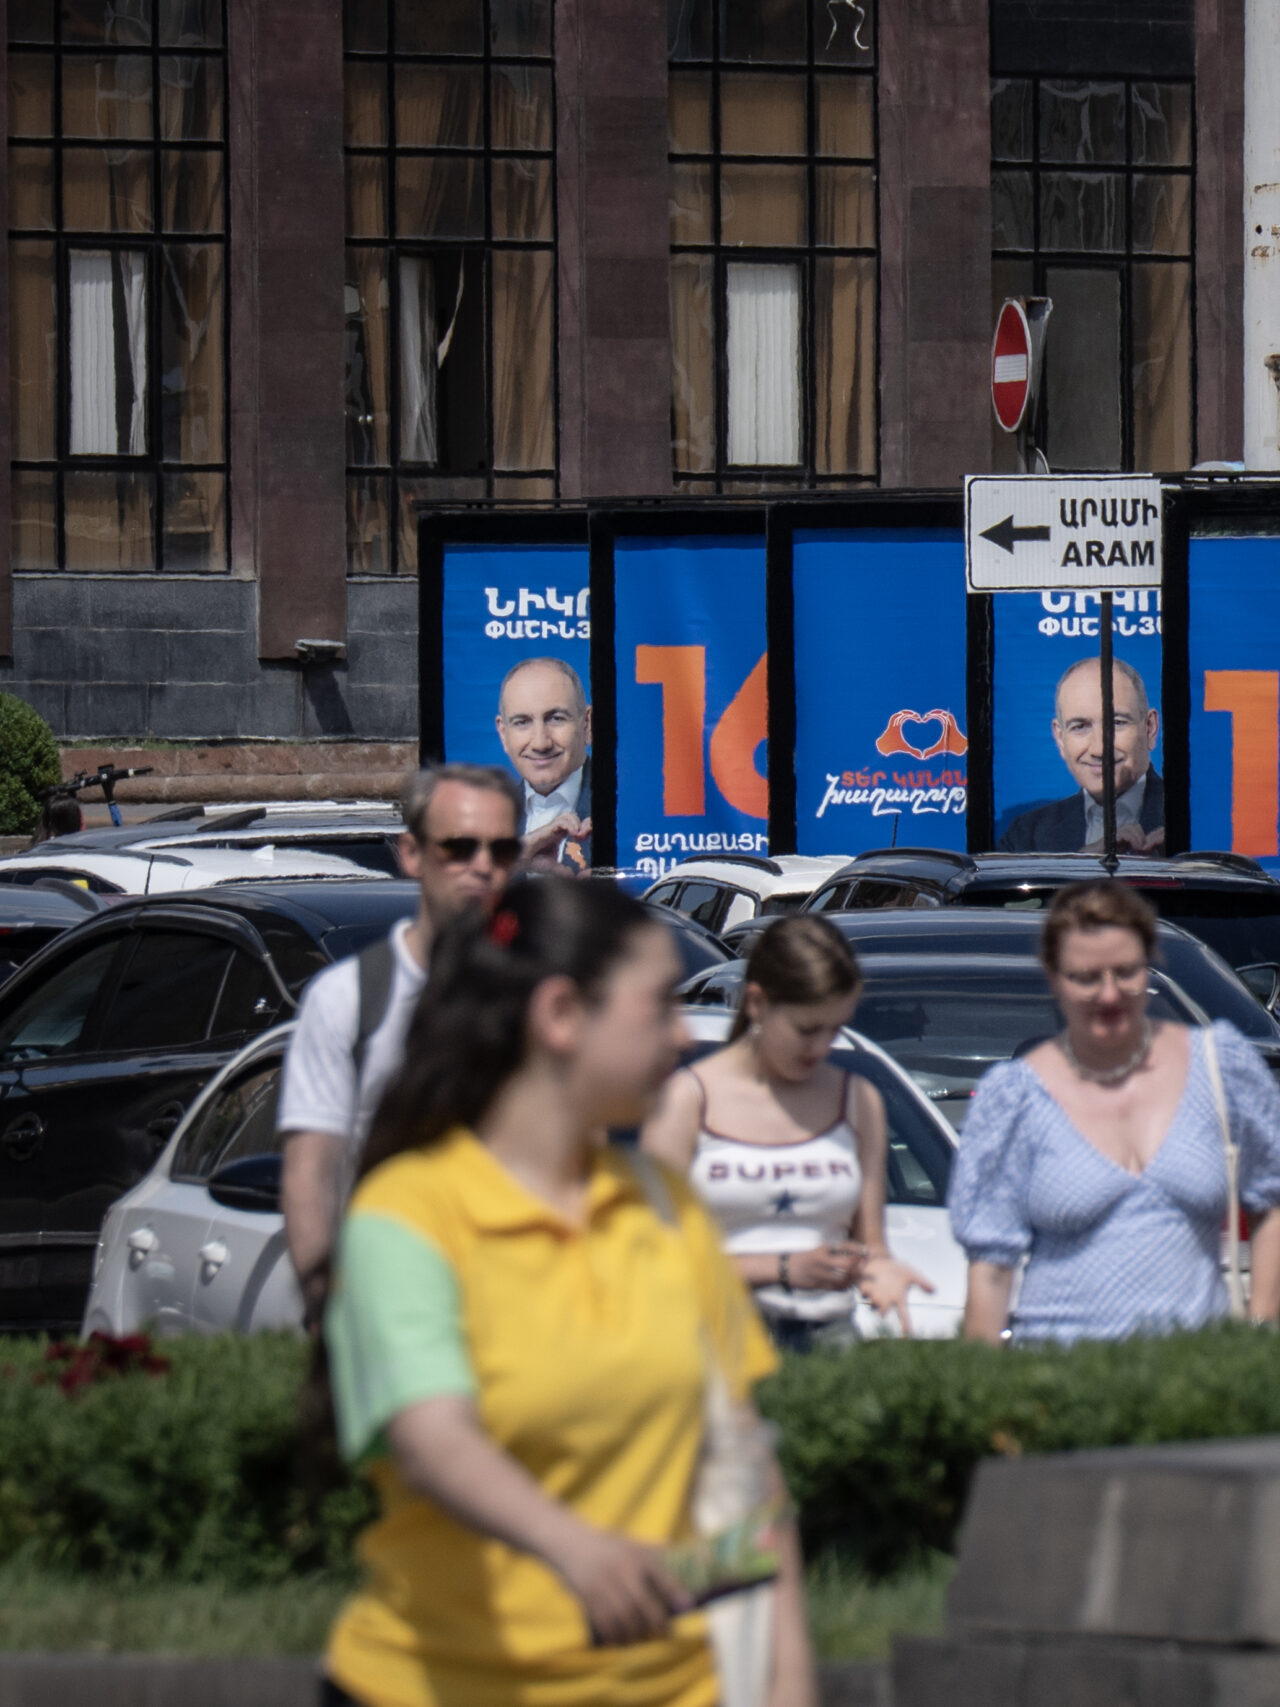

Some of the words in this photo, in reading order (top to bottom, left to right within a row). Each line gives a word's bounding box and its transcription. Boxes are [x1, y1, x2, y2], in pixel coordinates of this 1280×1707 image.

[1060, 499, 1158, 529] ԱՐԱՄԻ
[1061, 540, 1155, 567] ARAM
[707, 1161, 853, 1181] SUPER
